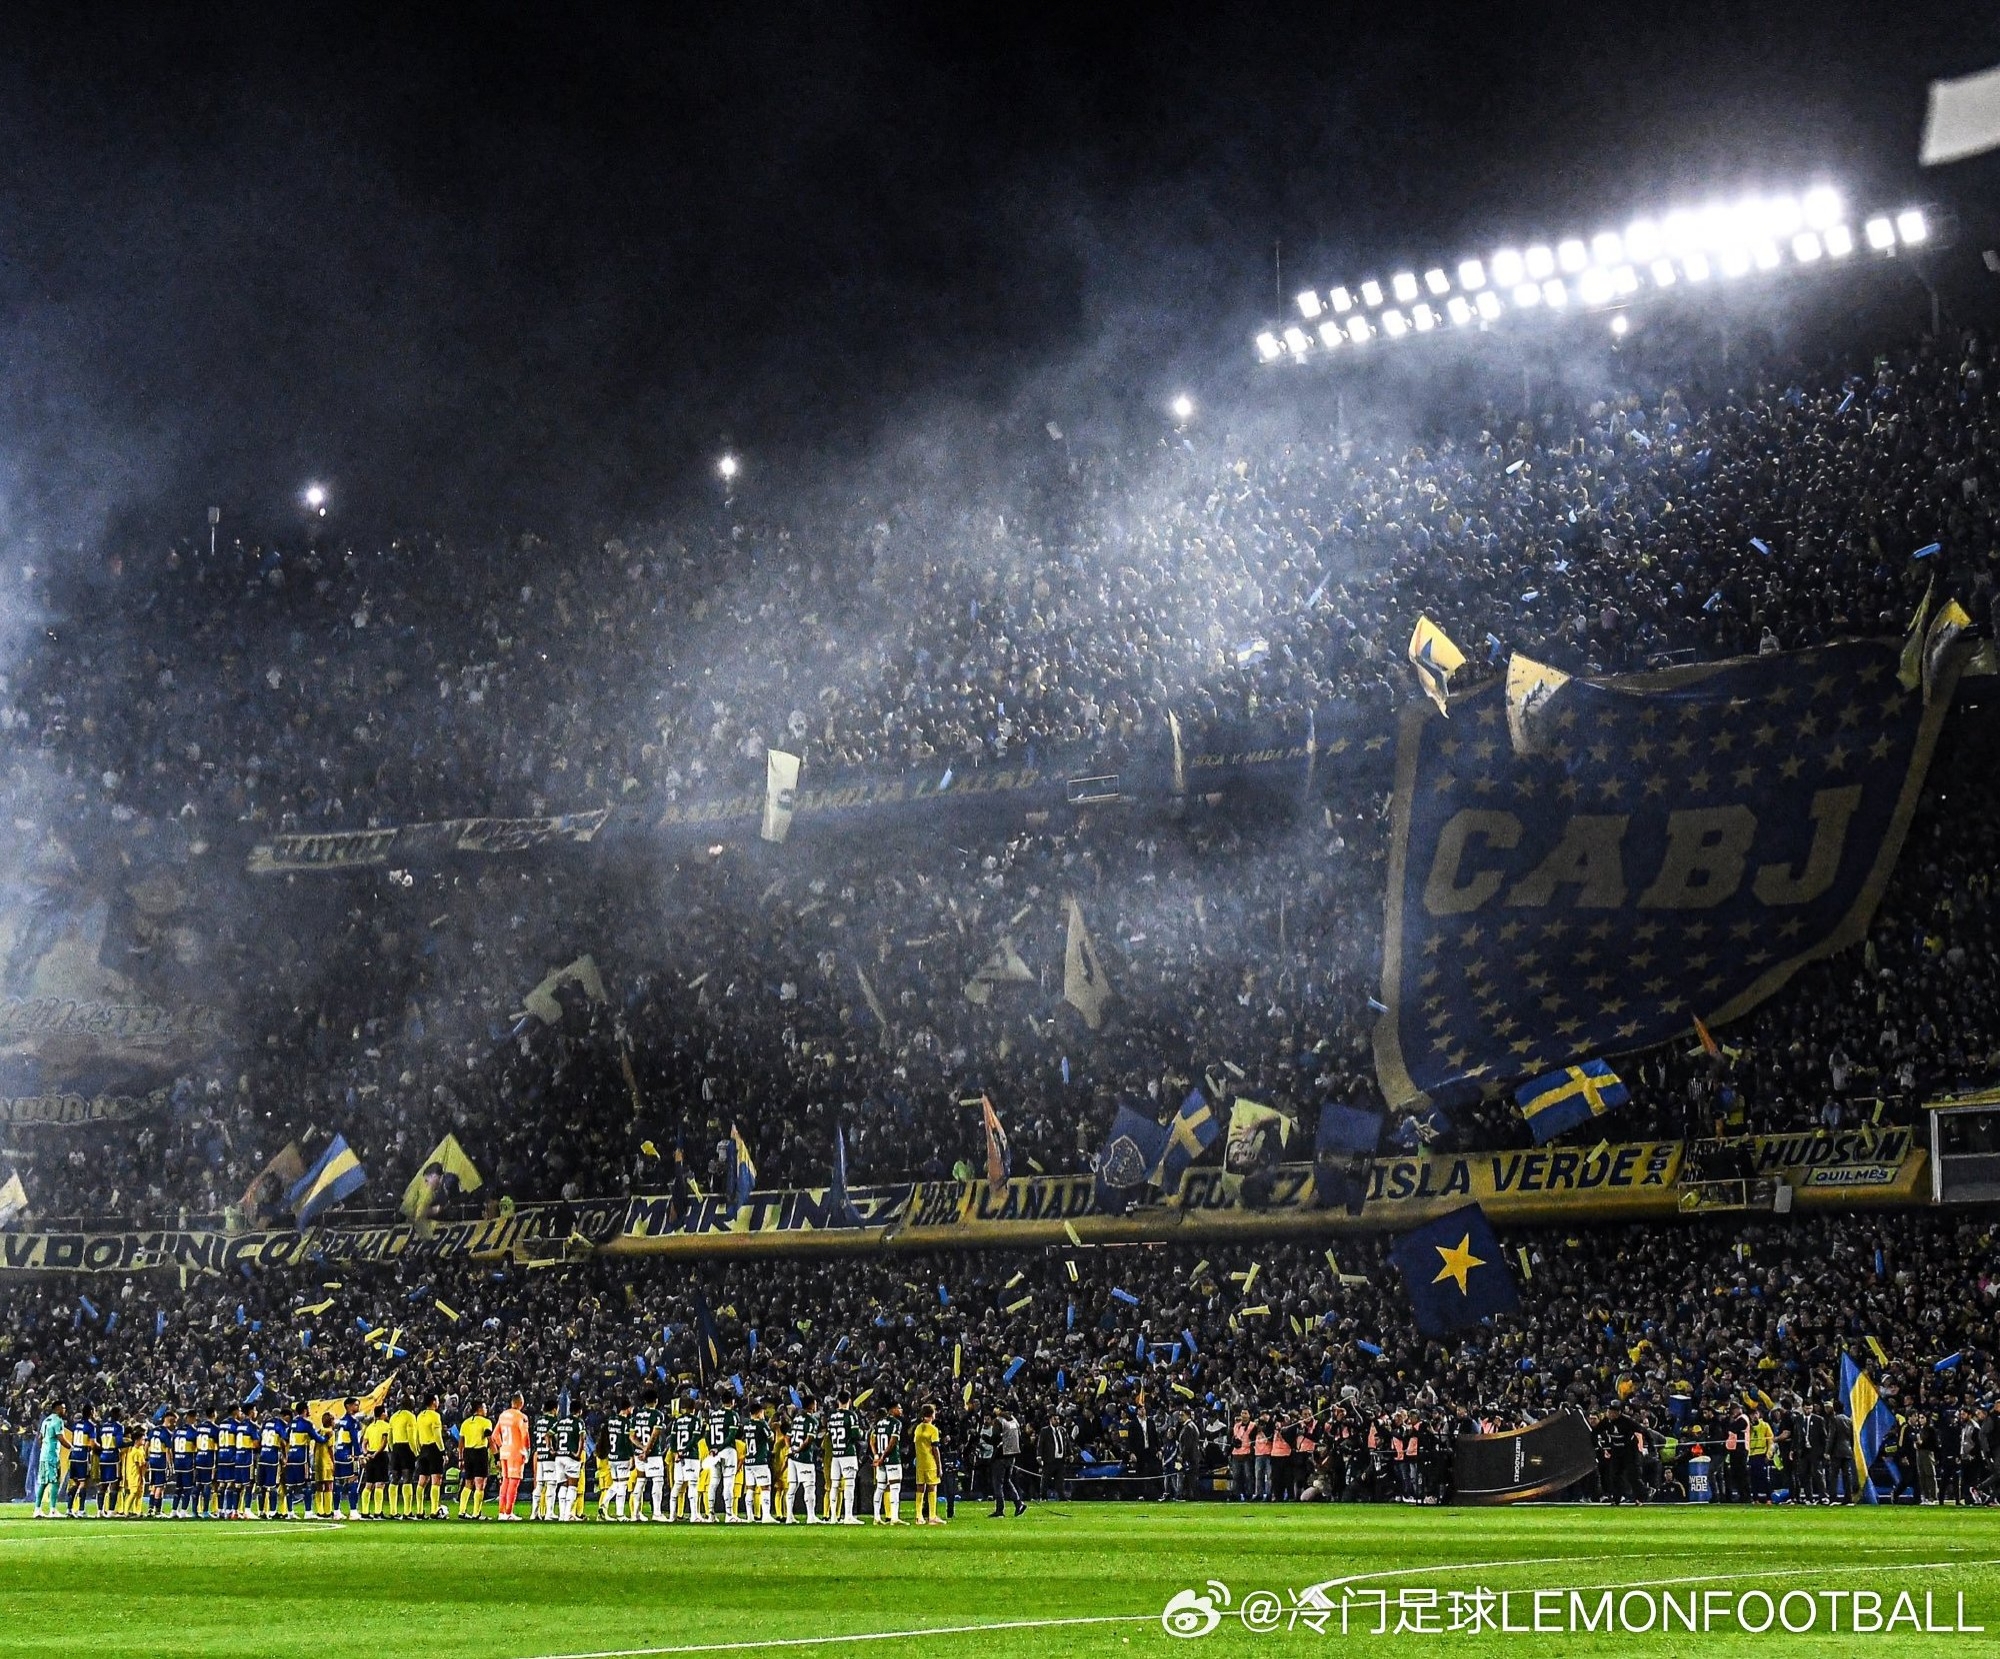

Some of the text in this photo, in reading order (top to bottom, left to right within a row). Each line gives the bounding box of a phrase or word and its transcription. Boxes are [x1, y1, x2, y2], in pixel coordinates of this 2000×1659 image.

[1422, 784, 1865, 917] CABJ
[1757, 1131, 1908, 1171] HUDSON
[1366, 1160, 1471, 1200] ISLA
[1494, 1149, 1642, 1191] VERDE
[1816, 1169, 1888, 1181] QUILMES
[559, 1432, 568, 1451] 2
[677, 1430, 690, 1452] 12
[710, 1424, 724, 1446] 15
[831, 1427, 846, 1449] 22
